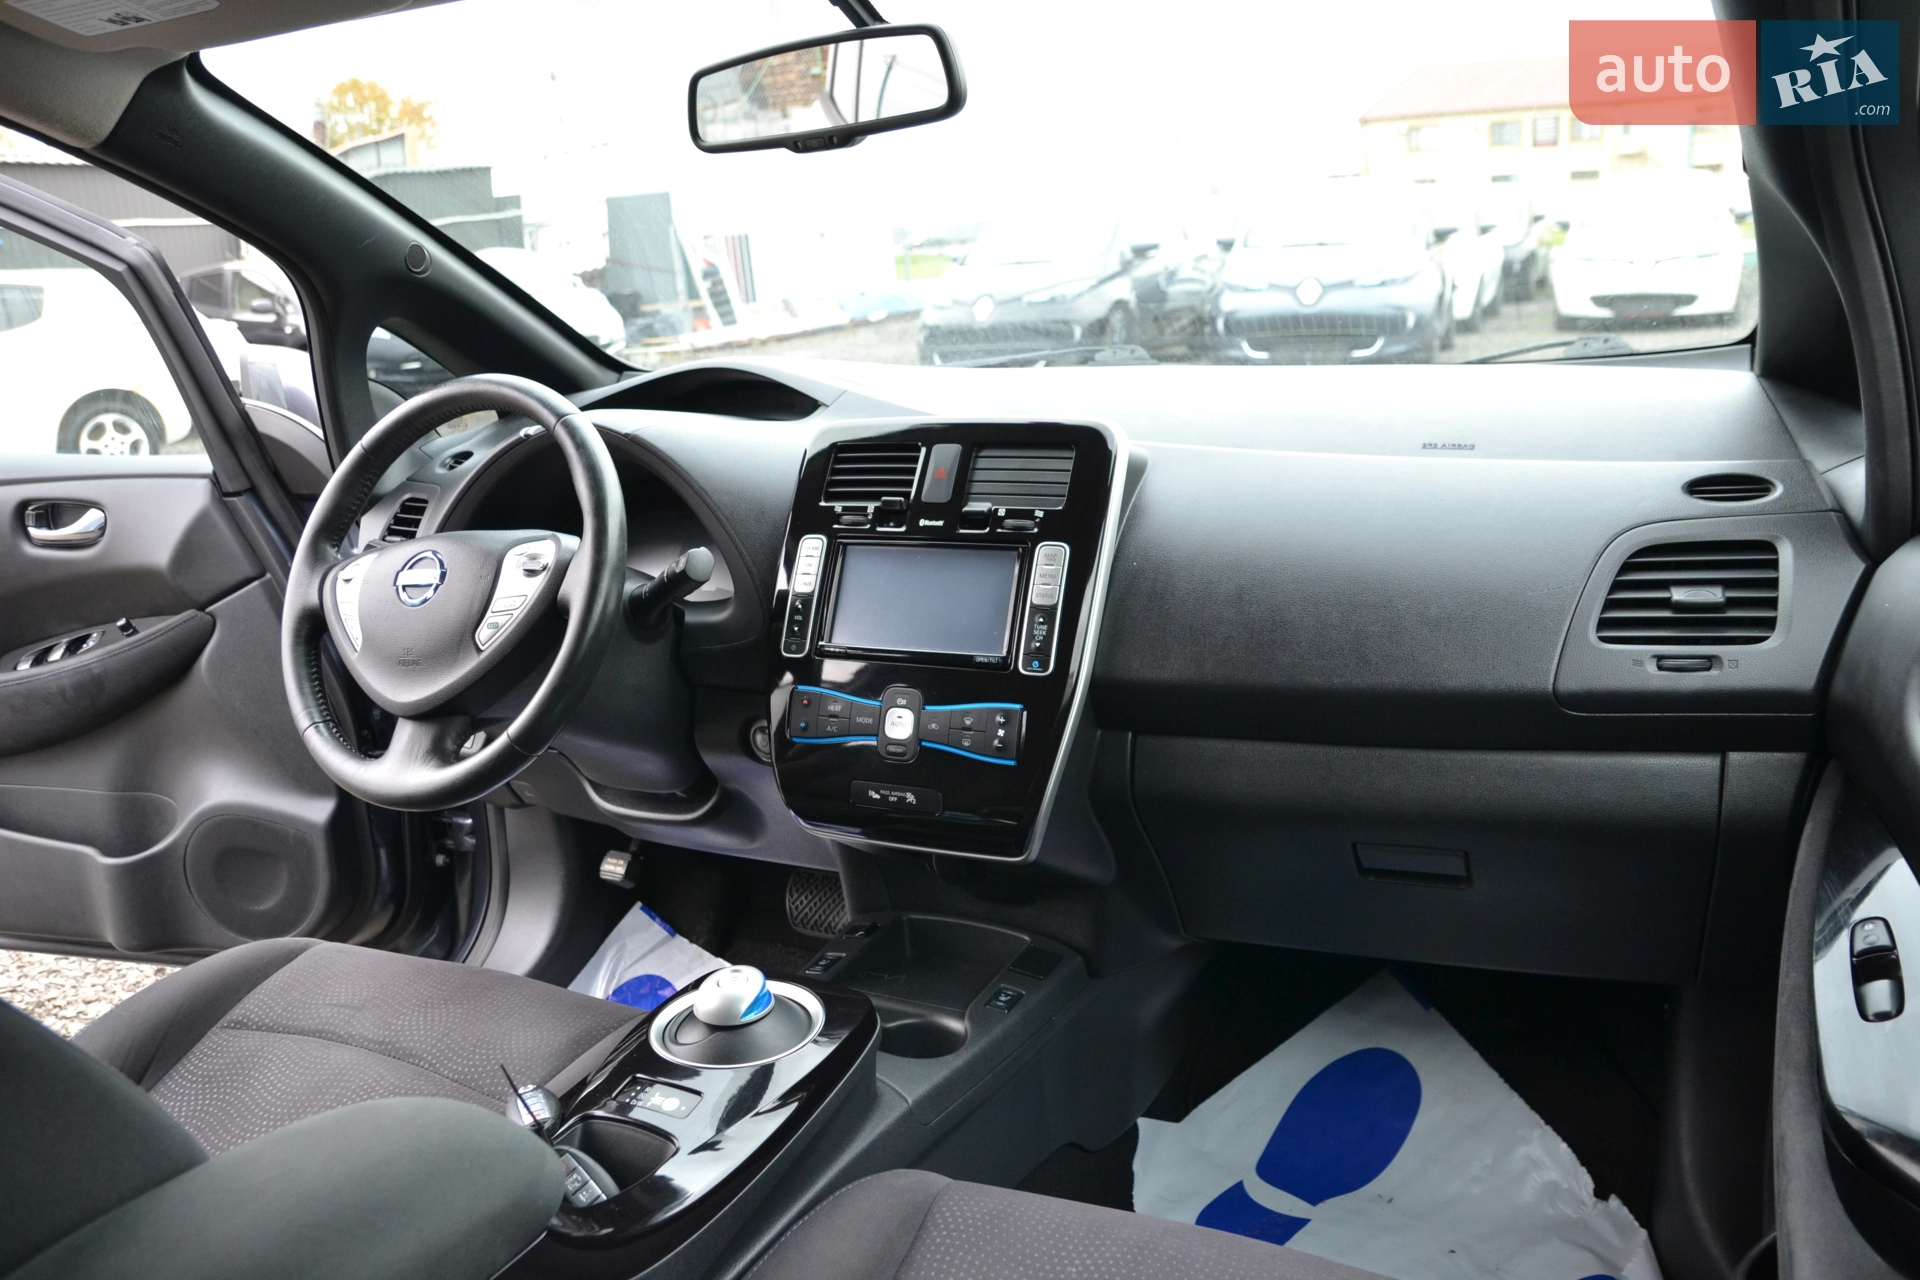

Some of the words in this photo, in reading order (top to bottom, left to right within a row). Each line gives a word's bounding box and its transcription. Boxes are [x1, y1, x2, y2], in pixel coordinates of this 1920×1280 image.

[1039, 572, 1057, 580] MENU
[856, 716, 874, 725] MODE
[890, 720, 907, 728] AUTO
[826, 725, 838, 733] A/C
